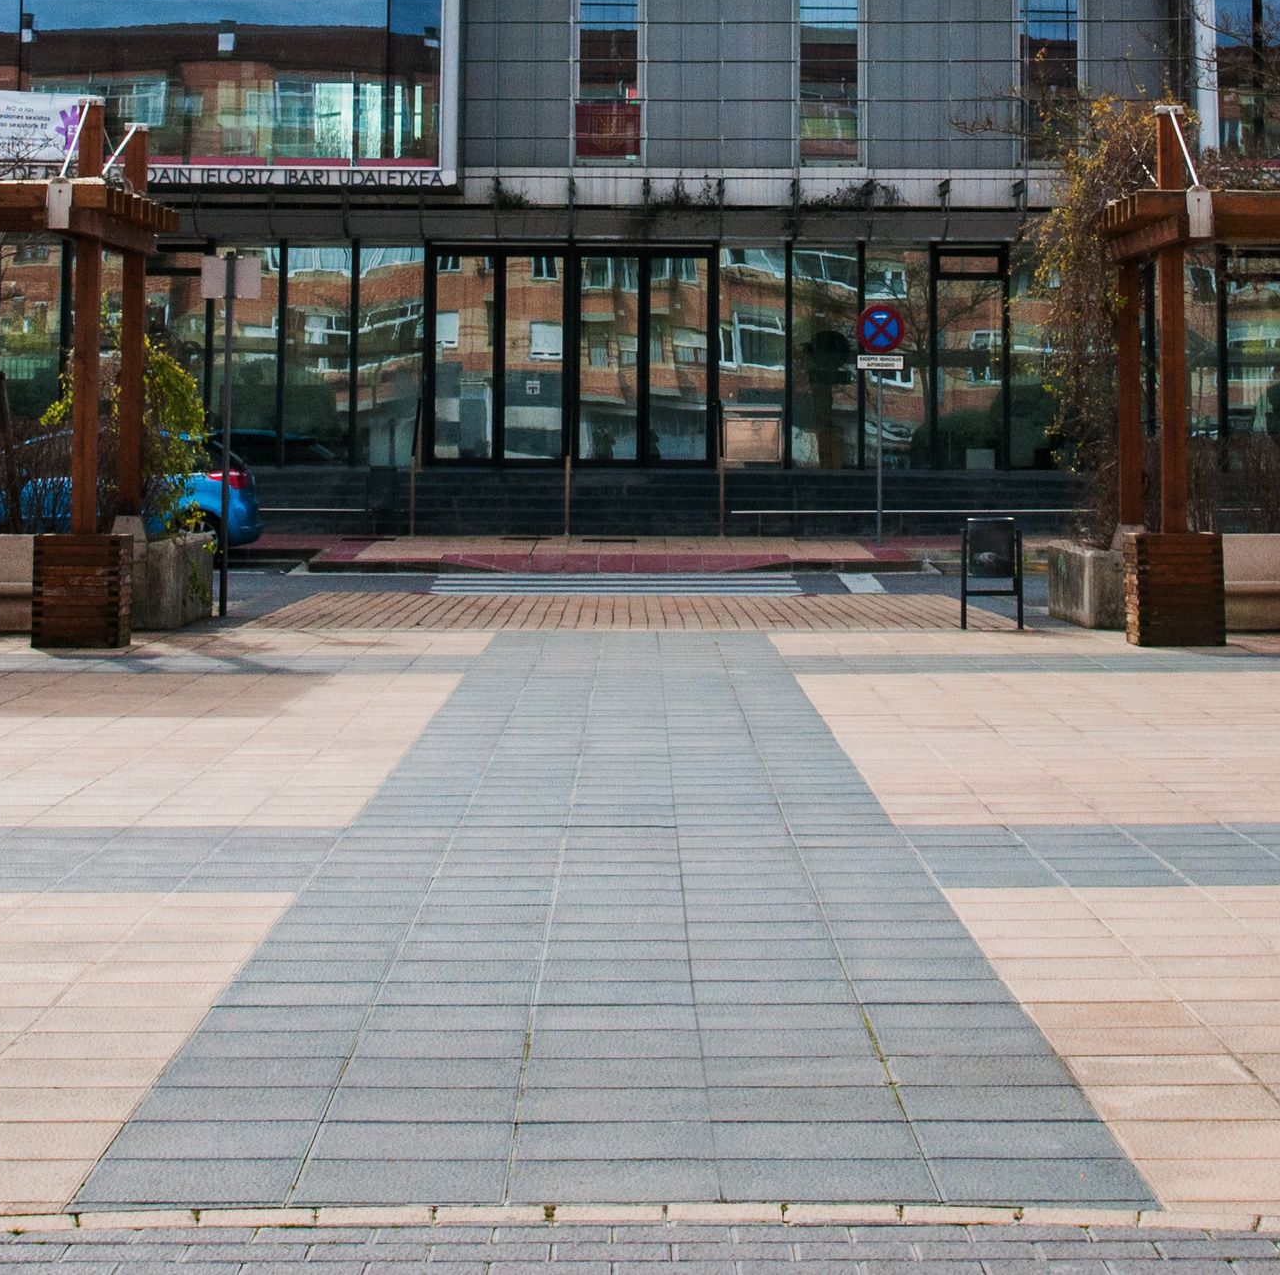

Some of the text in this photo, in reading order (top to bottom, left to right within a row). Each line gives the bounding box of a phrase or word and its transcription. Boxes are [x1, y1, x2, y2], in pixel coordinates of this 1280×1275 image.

[25, 114, 51, 122] sexistas
[201, 168, 274, 185] (ELORTZ
[285, 169, 329, 186] IBAR)
[339, 169, 444, 186] UDALETXEA
